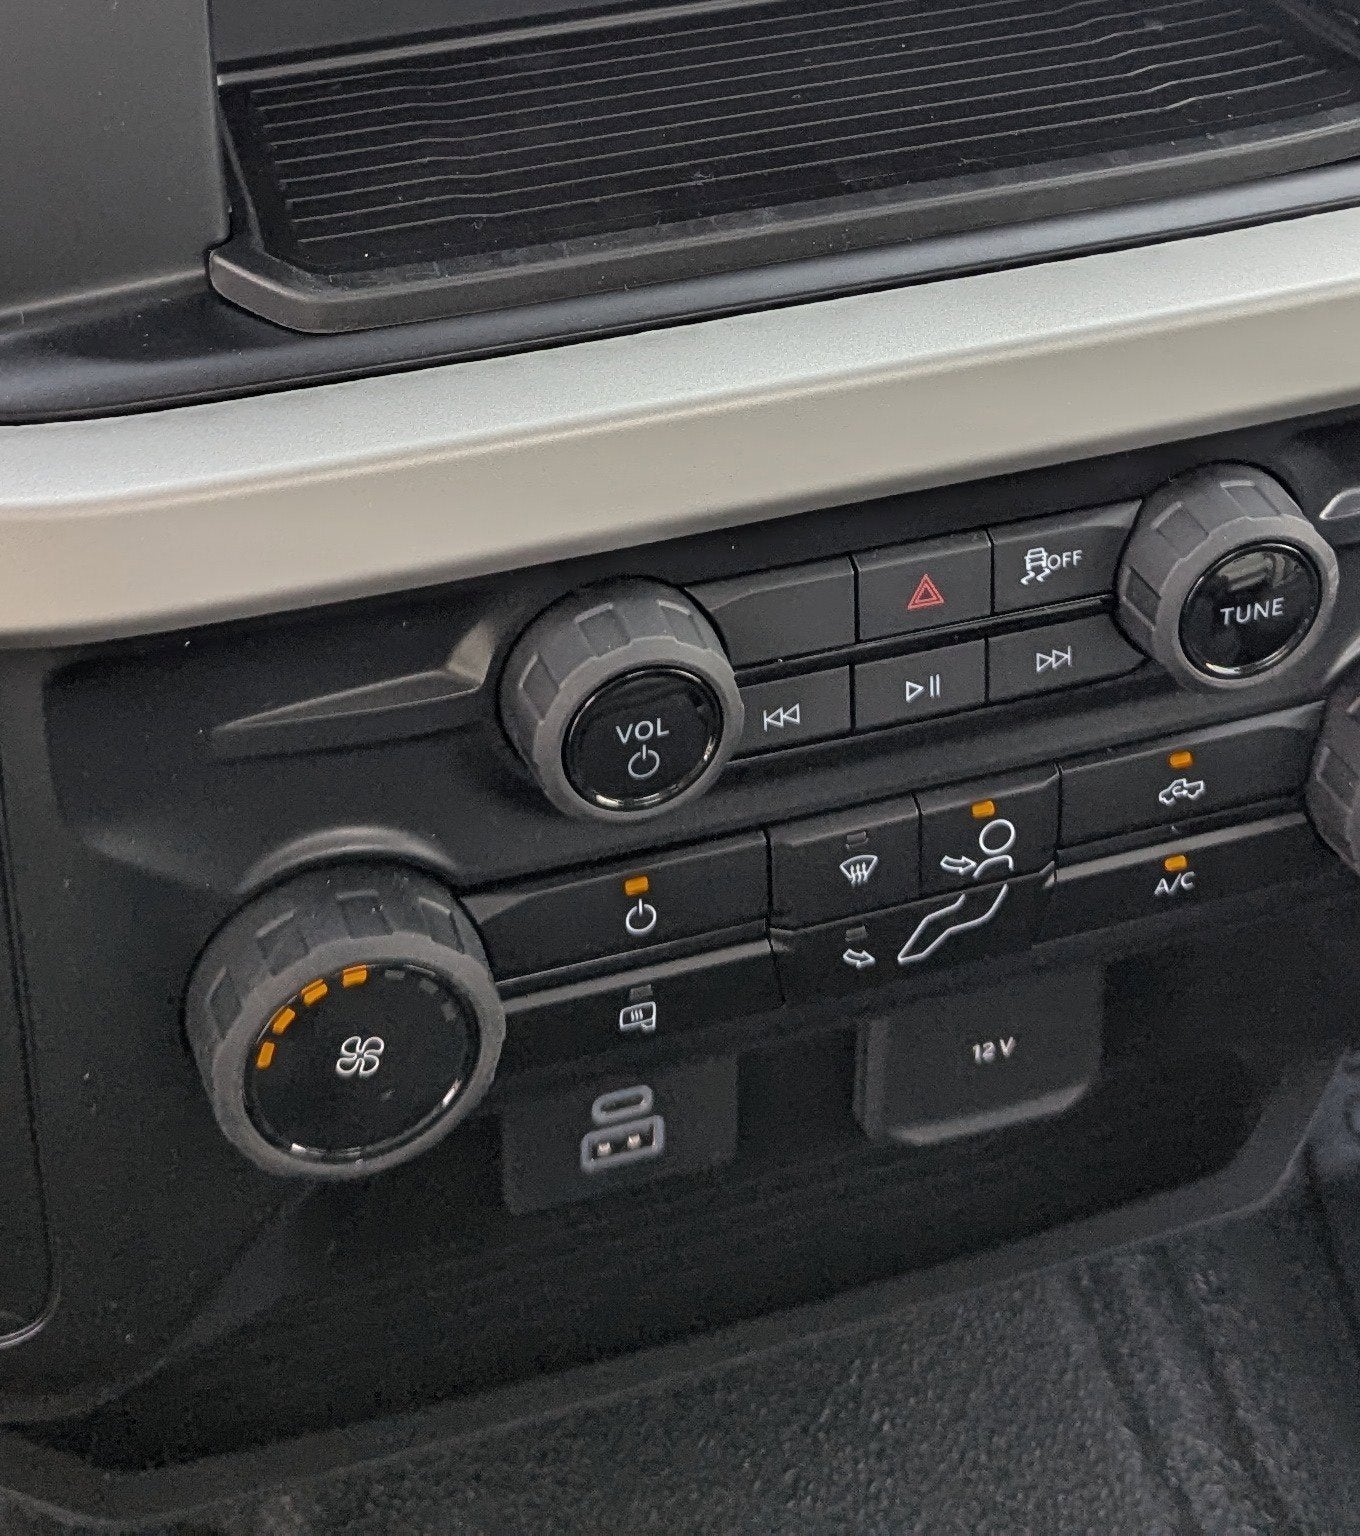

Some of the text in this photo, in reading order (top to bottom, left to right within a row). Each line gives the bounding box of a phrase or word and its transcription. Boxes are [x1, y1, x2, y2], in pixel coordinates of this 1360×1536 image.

[1046, 549, 1083, 571] OFF
[1219, 596, 1286, 626] TUNE
[615, 717, 670, 744] VOL
[1153, 870, 1196, 896] A/C
